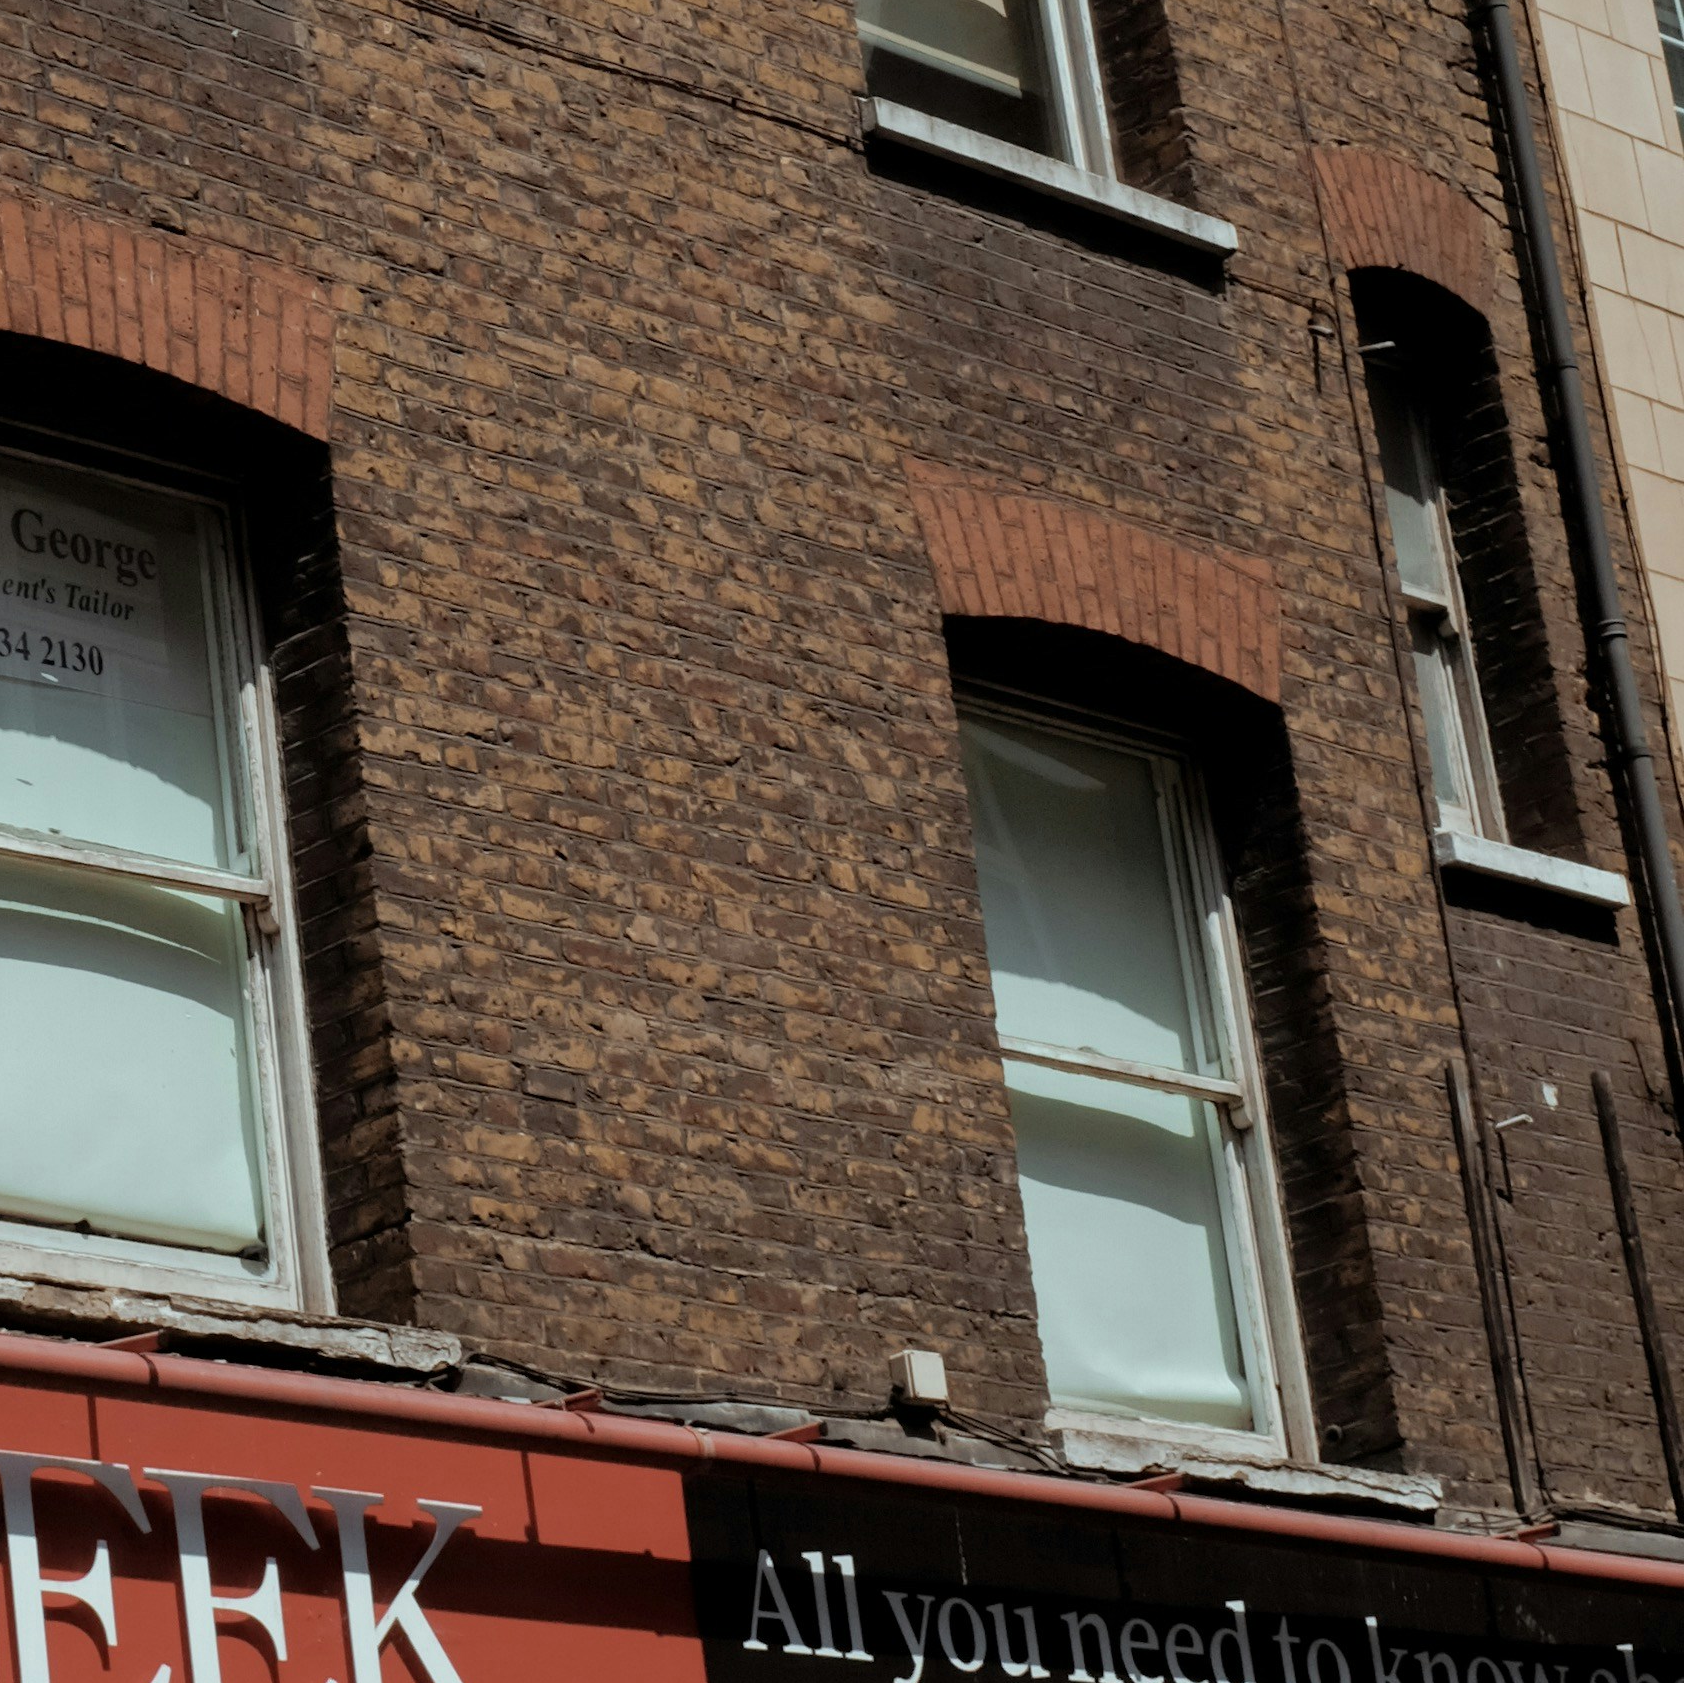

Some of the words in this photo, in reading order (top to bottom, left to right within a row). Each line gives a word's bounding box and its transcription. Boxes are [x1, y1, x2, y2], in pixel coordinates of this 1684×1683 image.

[10, 507, 157, 587] George
[64, 582, 135, 620] Tailor
[40, 635, 104, 677] 2130
[743, 1548, 874, 1662] All
